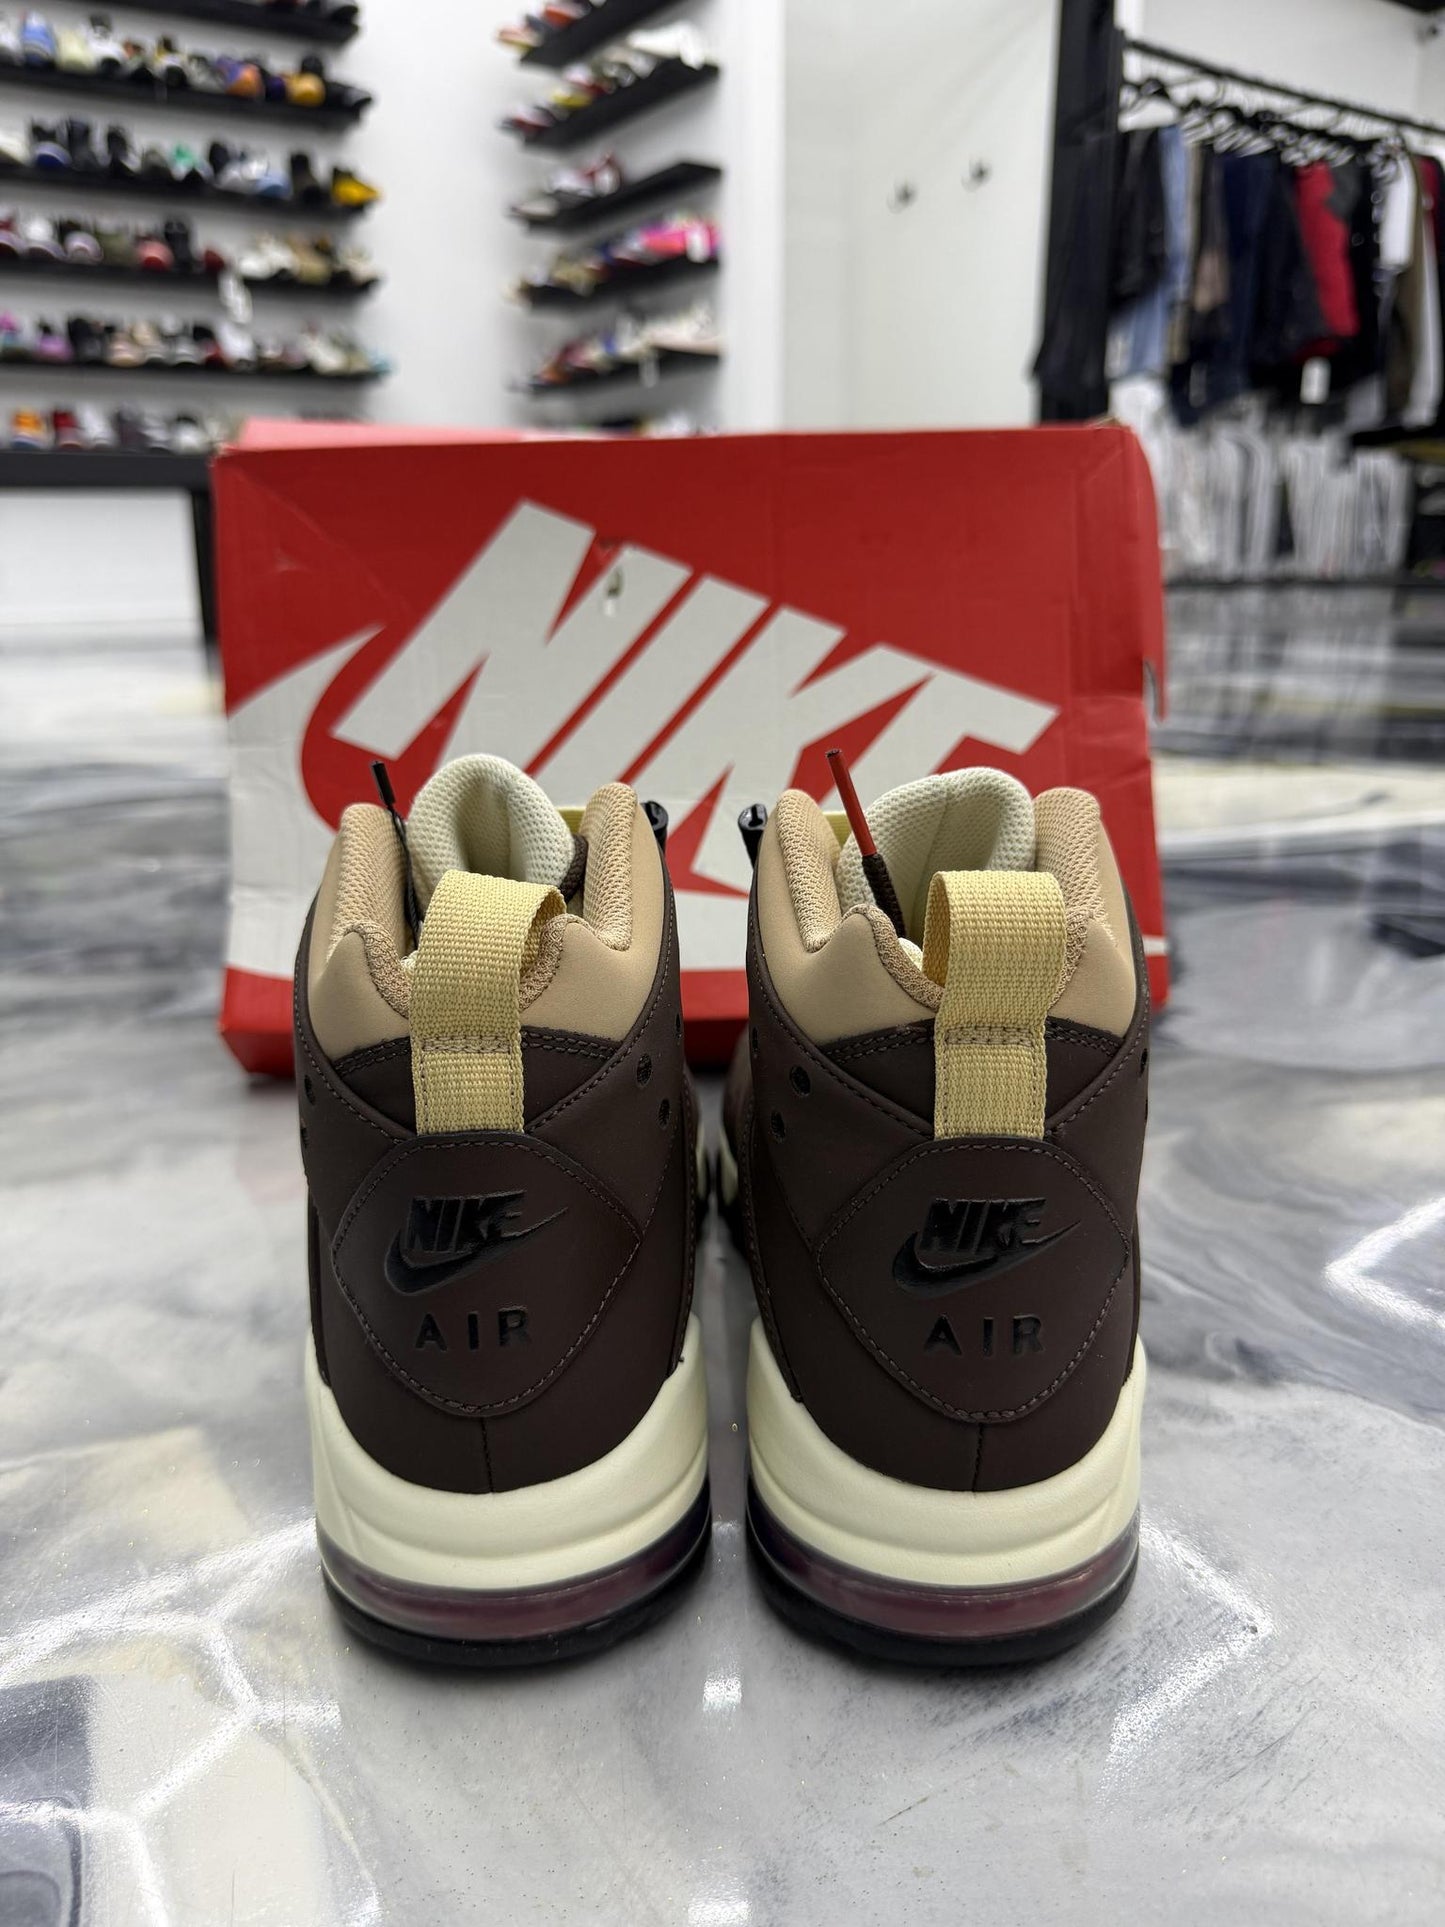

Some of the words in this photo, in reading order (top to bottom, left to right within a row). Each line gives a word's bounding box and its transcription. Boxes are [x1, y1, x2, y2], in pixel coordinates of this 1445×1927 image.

[404, 1190, 527, 1254] NIKE
[917, 1197, 1047, 1255] NIKE
[415, 1304, 529, 1350] AIR
[924, 1313, 1045, 1354] AIR
